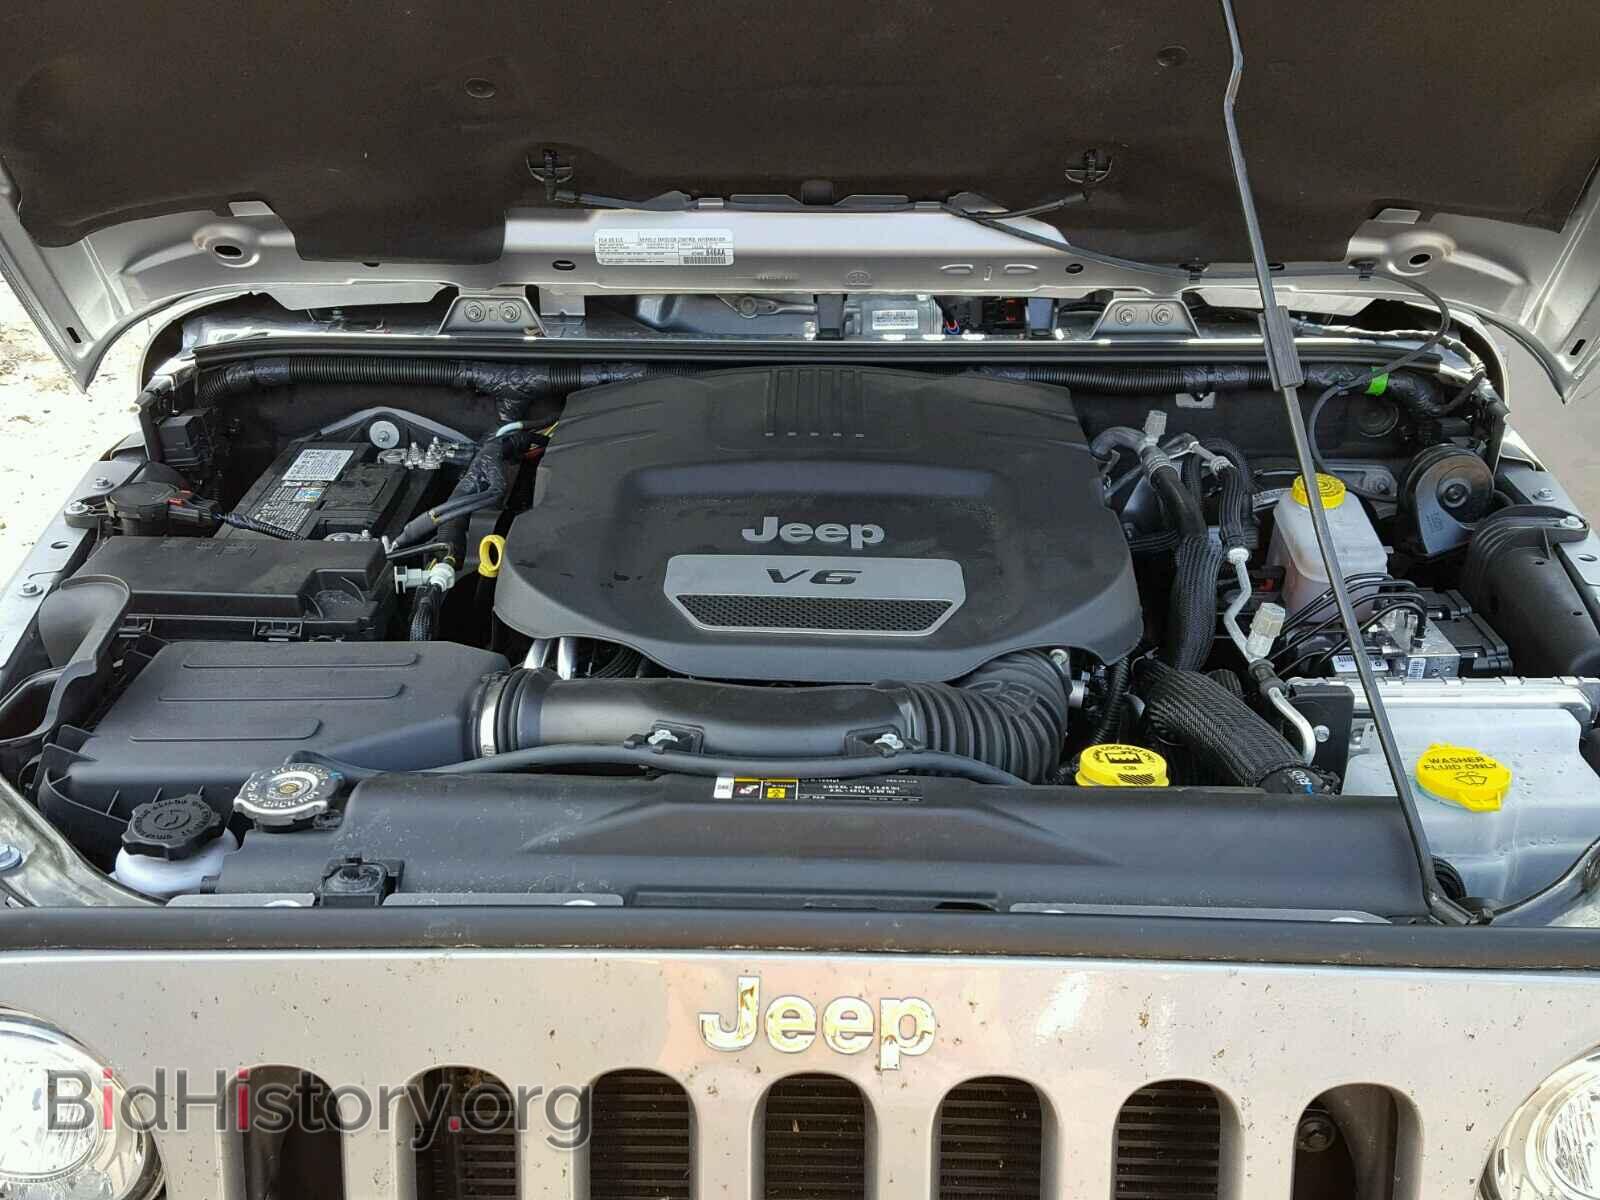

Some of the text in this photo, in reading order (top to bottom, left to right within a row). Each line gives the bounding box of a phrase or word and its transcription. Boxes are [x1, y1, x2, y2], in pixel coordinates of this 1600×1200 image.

[742, 516, 885, 550] Jeep
[766, 568, 863, 585] V6
[1428, 756, 1485, 764] WASHER
[698, 976, 936, 1071] Jeep
